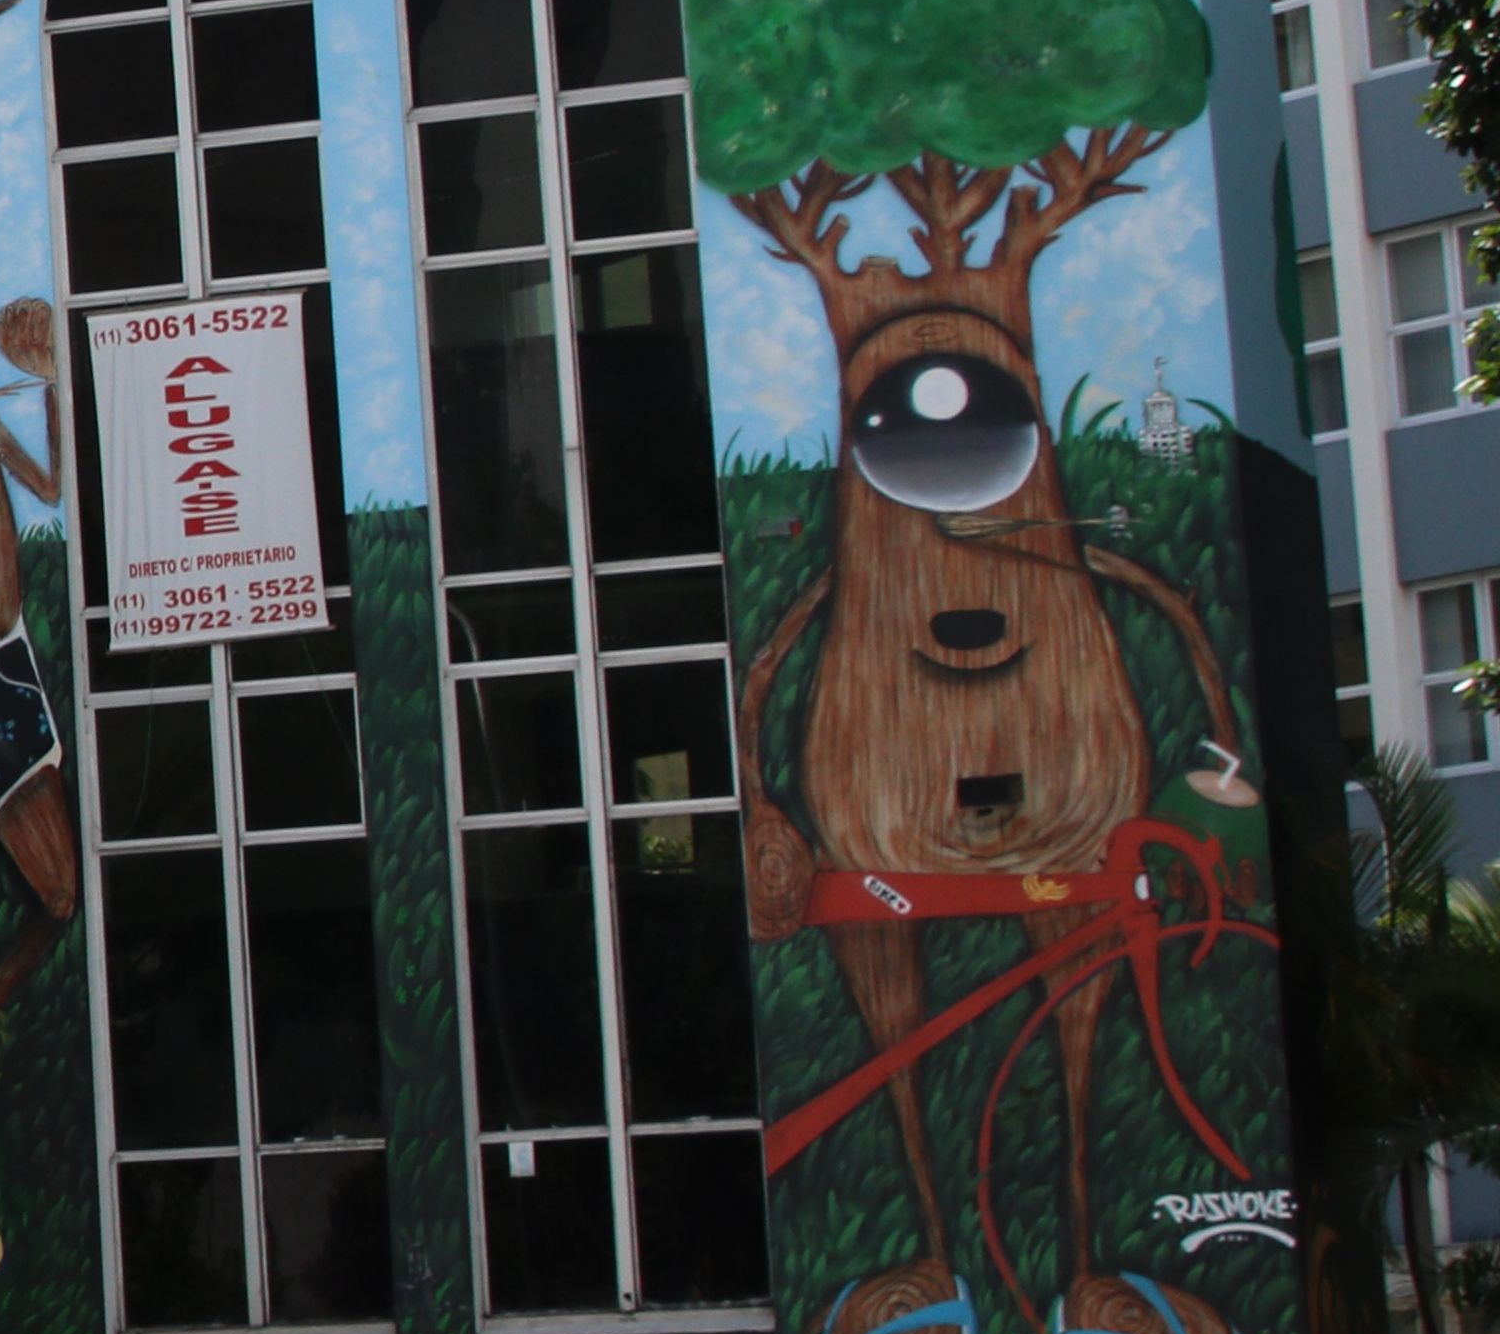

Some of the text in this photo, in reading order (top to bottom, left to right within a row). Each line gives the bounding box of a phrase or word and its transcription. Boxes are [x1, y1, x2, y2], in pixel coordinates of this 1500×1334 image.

[94, 304, 289, 349] (11) 3061-5522
[164, 355, 242, 538] ALUGA-SE
[129, 559, 177, 579] DIRETO
[196, 544, 297, 572] PROPRIETÁRIO
[114, 593, 146, 612] (11)
[164, 583, 228, 608] 3061
[249, 574, 316, 600] 5522
[250, 599, 318, 624] 2299
